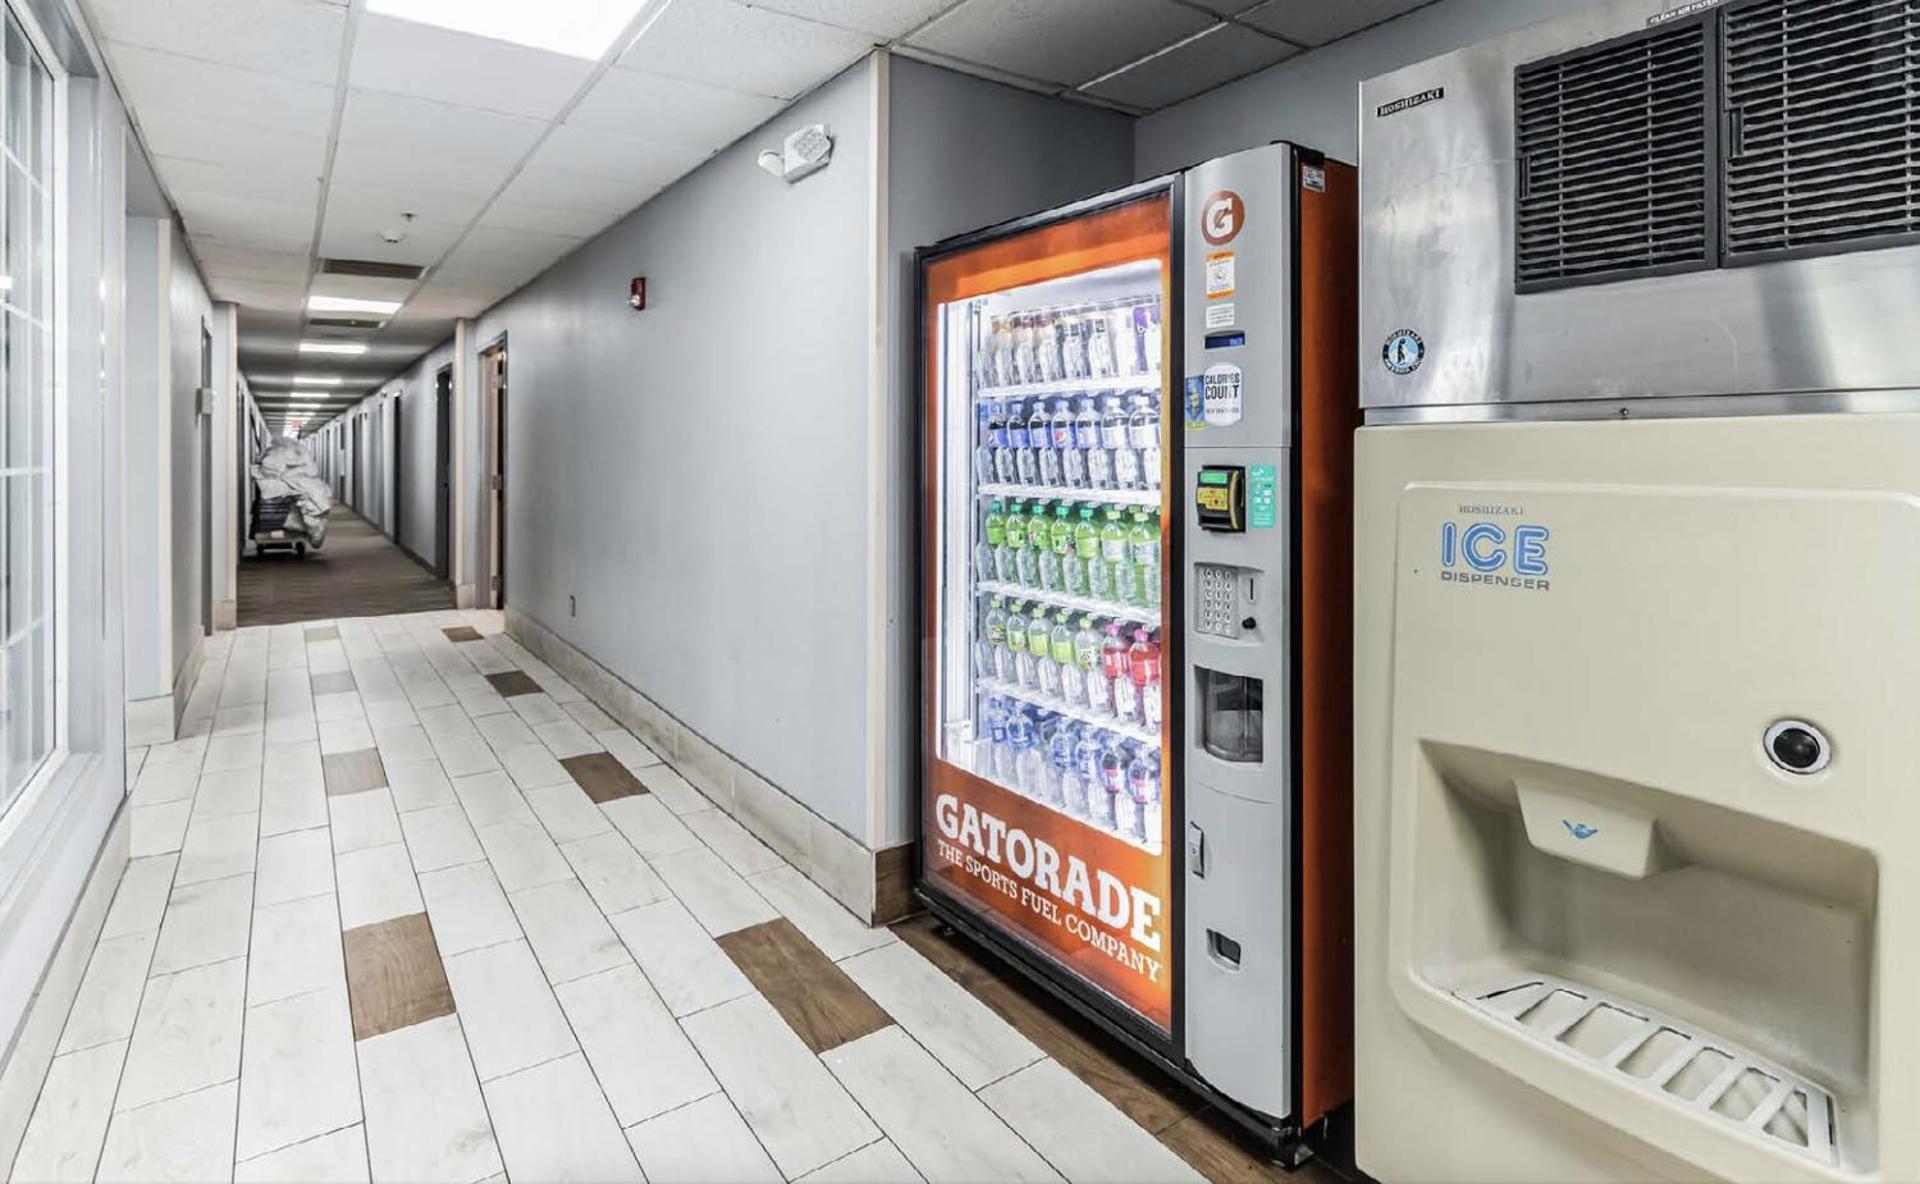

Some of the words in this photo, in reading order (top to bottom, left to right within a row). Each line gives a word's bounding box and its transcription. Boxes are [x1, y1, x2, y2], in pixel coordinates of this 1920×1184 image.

[1379, 89, 1441, 117] HOSHIZAKI
[1206, 197, 1233, 238] G
[1458, 504, 1524, 515] HOSHIZAKI
[1442, 522, 1549, 575] ICE
[1440, 571, 1550, 591] DISPENSER
[936, 793, 1161, 952] GATORADE
[937, 839, 963, 867] THE
[966, 856, 1018, 899] SPORTS
[1021, 888, 1062, 925] FUEL
[1065, 914, 1162, 983] COMPANY
